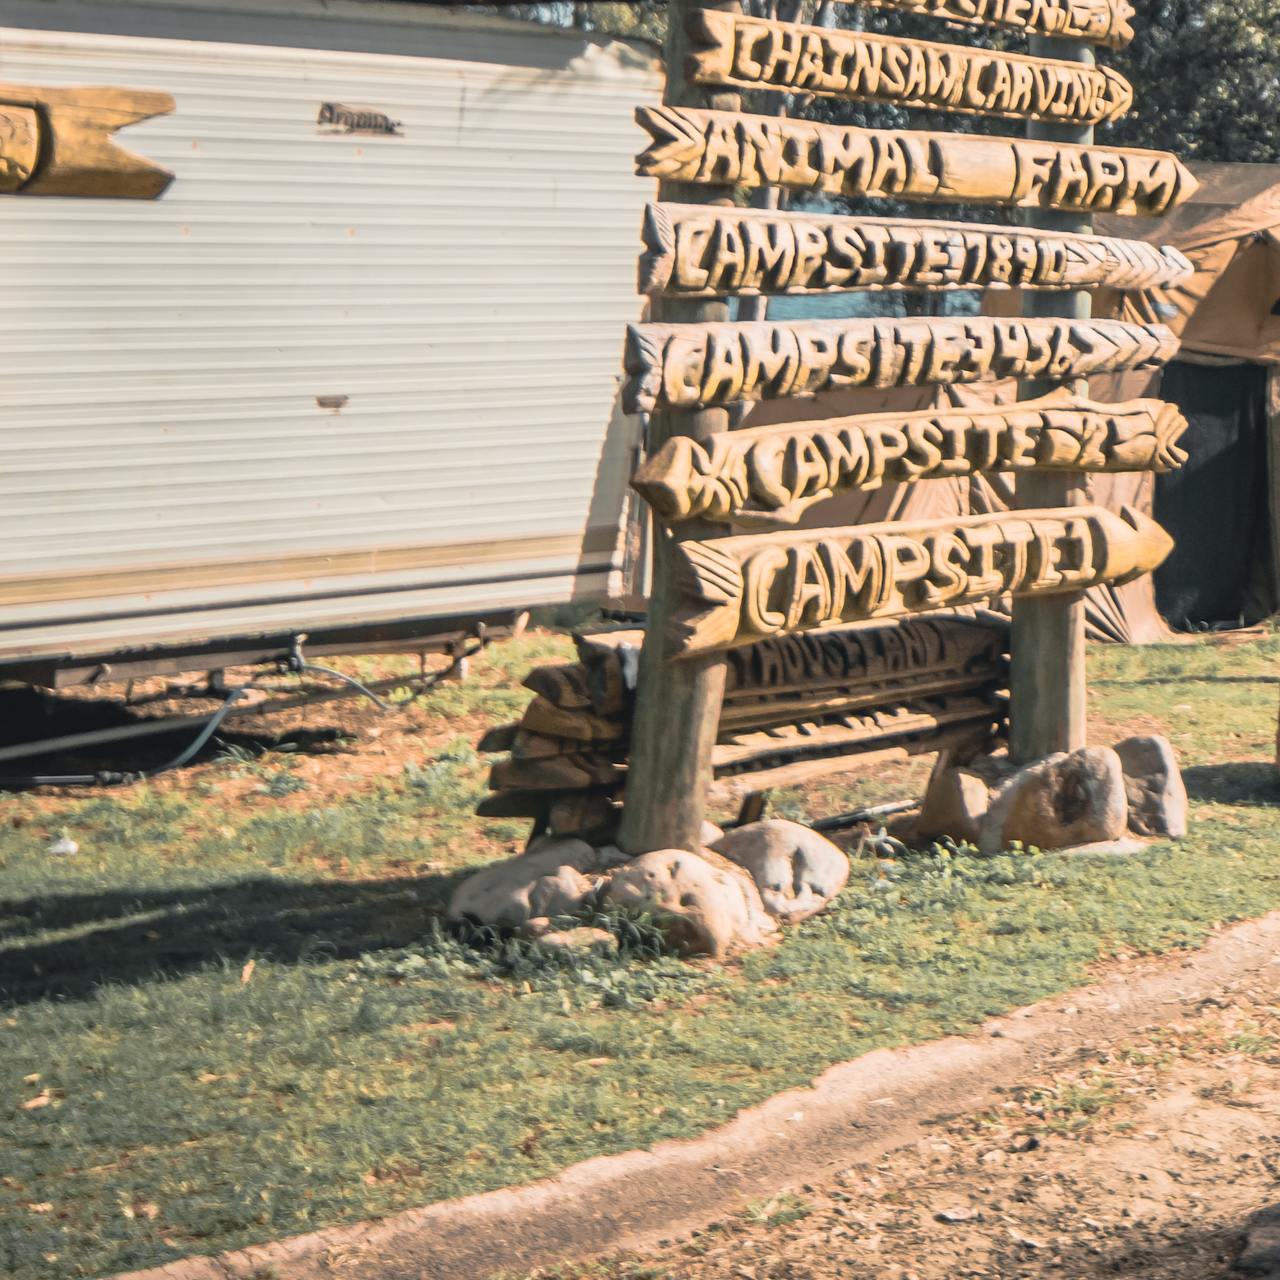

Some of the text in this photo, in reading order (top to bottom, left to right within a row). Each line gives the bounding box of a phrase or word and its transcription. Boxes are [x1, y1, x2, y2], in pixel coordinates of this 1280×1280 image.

[737, 25, 1107, 118] CHAINSAW CARVING
[696, 120, 1176, 215] ANIMAL FARM
[676, 219, 950, 290] CAMPSITE
[664, 324, 962, 405] CAMPSITE
[753, 415, 1043, 506] CAMPSITE
[748, 521, 1063, 634] CAMPSITE
